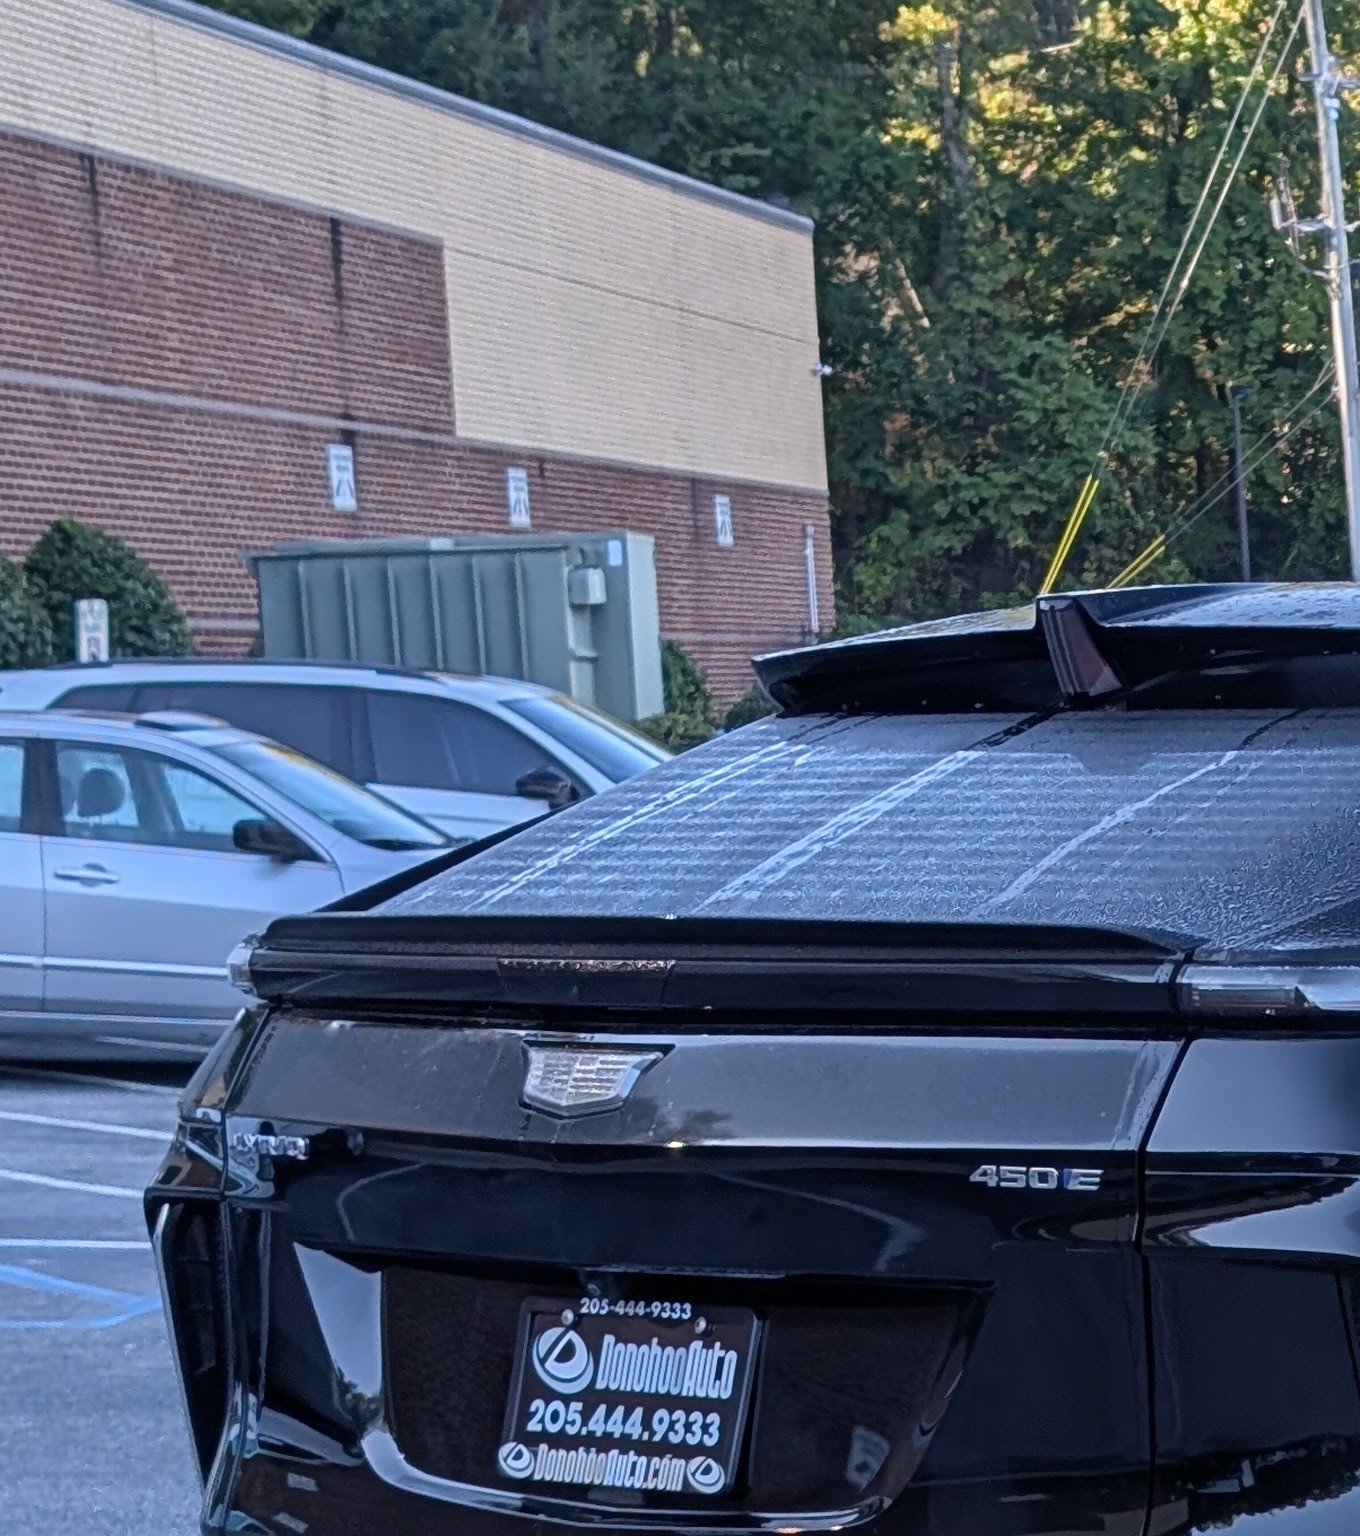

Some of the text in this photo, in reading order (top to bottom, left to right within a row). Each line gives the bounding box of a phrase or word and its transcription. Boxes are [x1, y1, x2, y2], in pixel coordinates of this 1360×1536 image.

[969, 1165, 1104, 1191] 450 E
[580, 1297, 692, 1321] 205-444-9333
[595, 1334, 738, 1400] DonohooAuto
[526, 1399, 720, 1447] 205.444.9333
[534, 1443, 686, 1491] DonohooAuto.com
